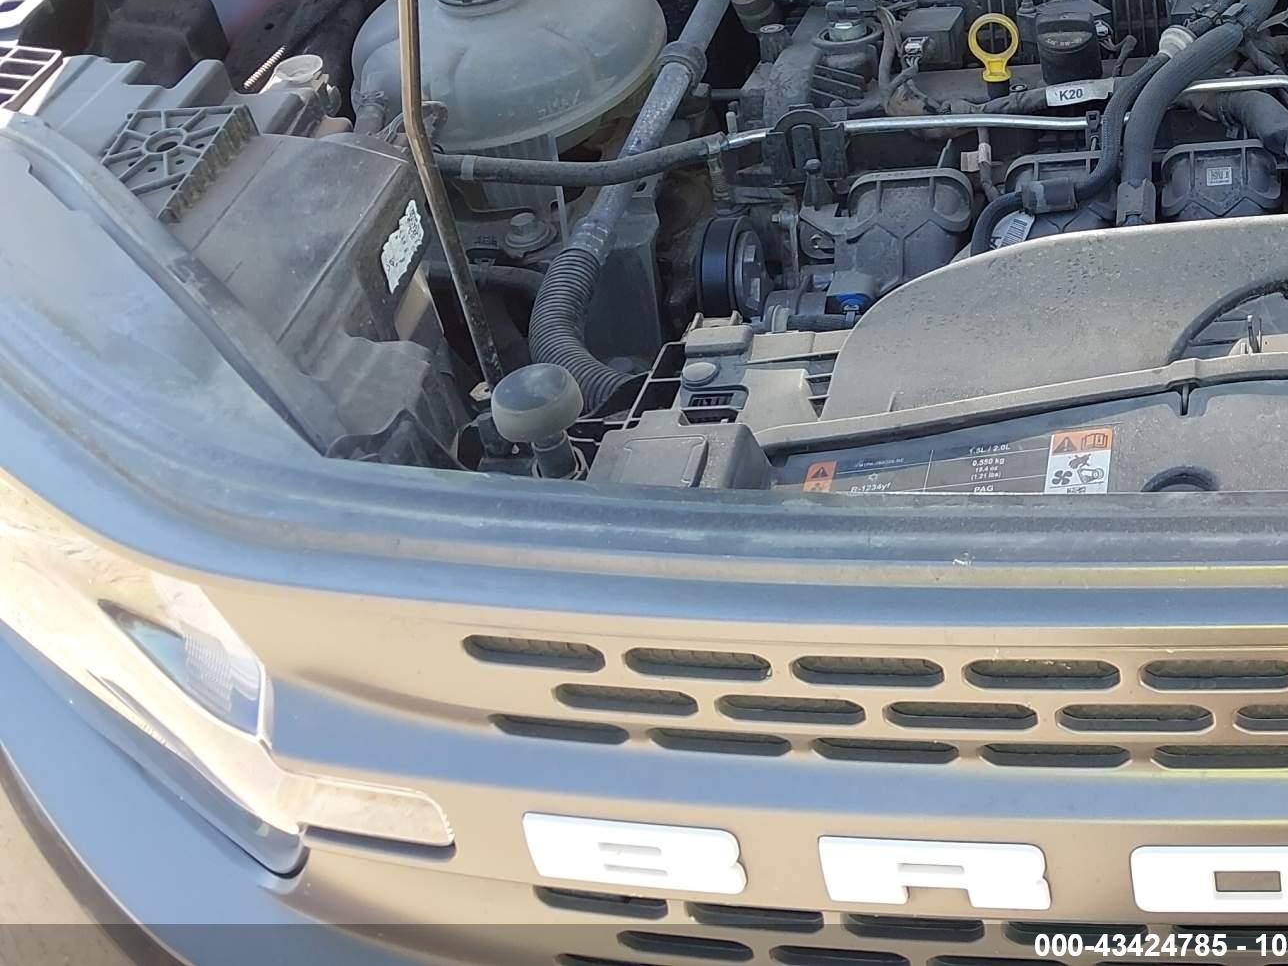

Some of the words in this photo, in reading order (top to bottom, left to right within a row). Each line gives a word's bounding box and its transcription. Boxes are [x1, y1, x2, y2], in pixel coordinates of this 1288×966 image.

[1059, 89, 1083, 101] K20
[993, 443, 1011, 452] 2.0L
[973, 485, 994, 493] PAG
